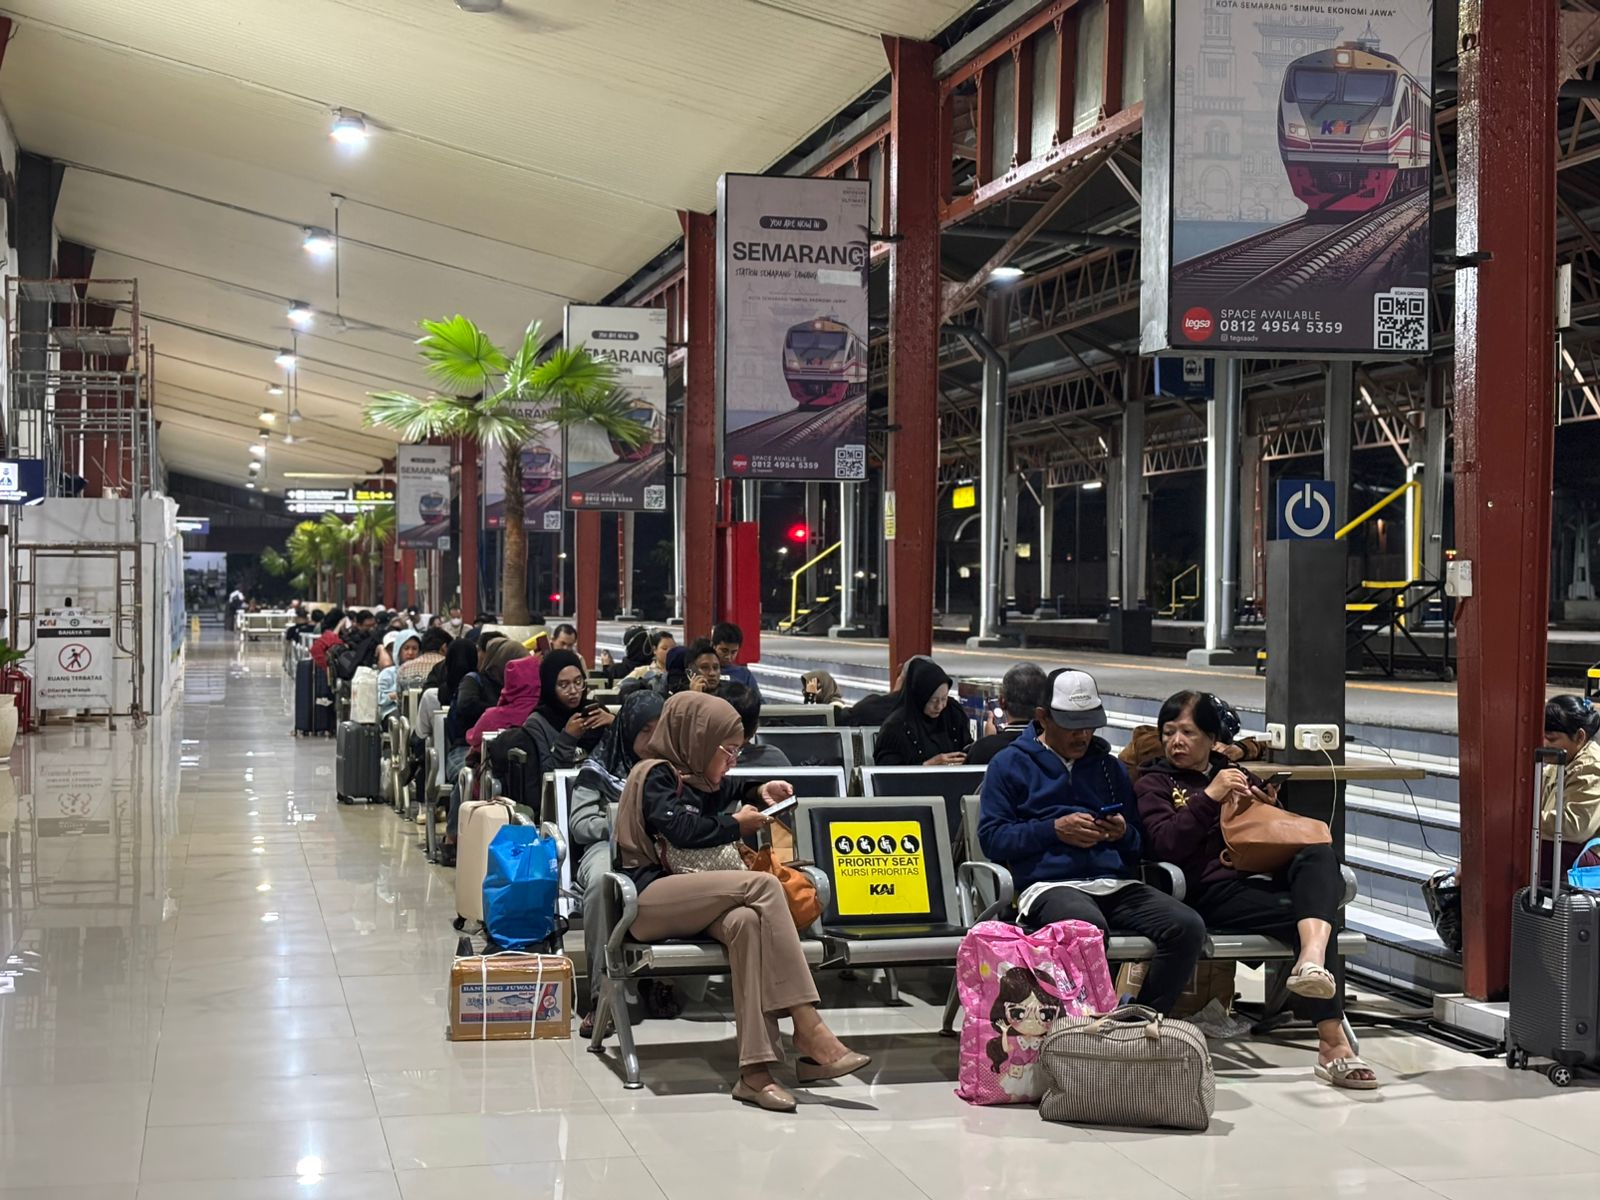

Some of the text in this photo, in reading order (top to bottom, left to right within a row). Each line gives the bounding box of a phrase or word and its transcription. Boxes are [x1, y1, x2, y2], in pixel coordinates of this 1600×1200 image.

[1216, 0, 1396, 17] KOTA SEMARANG "SIMPUL EKONOMI JAWA"
[732, 241, 864, 266] SEMARANG
[1221, 309, 1321, 321] SPACE AVAILABLE
[1220, 320, 1343, 333] 0812 4954 5359
[837, 857, 920, 867] PRIORITY SEAT
[841, 867, 920, 877] KURSI PRIORITAS
